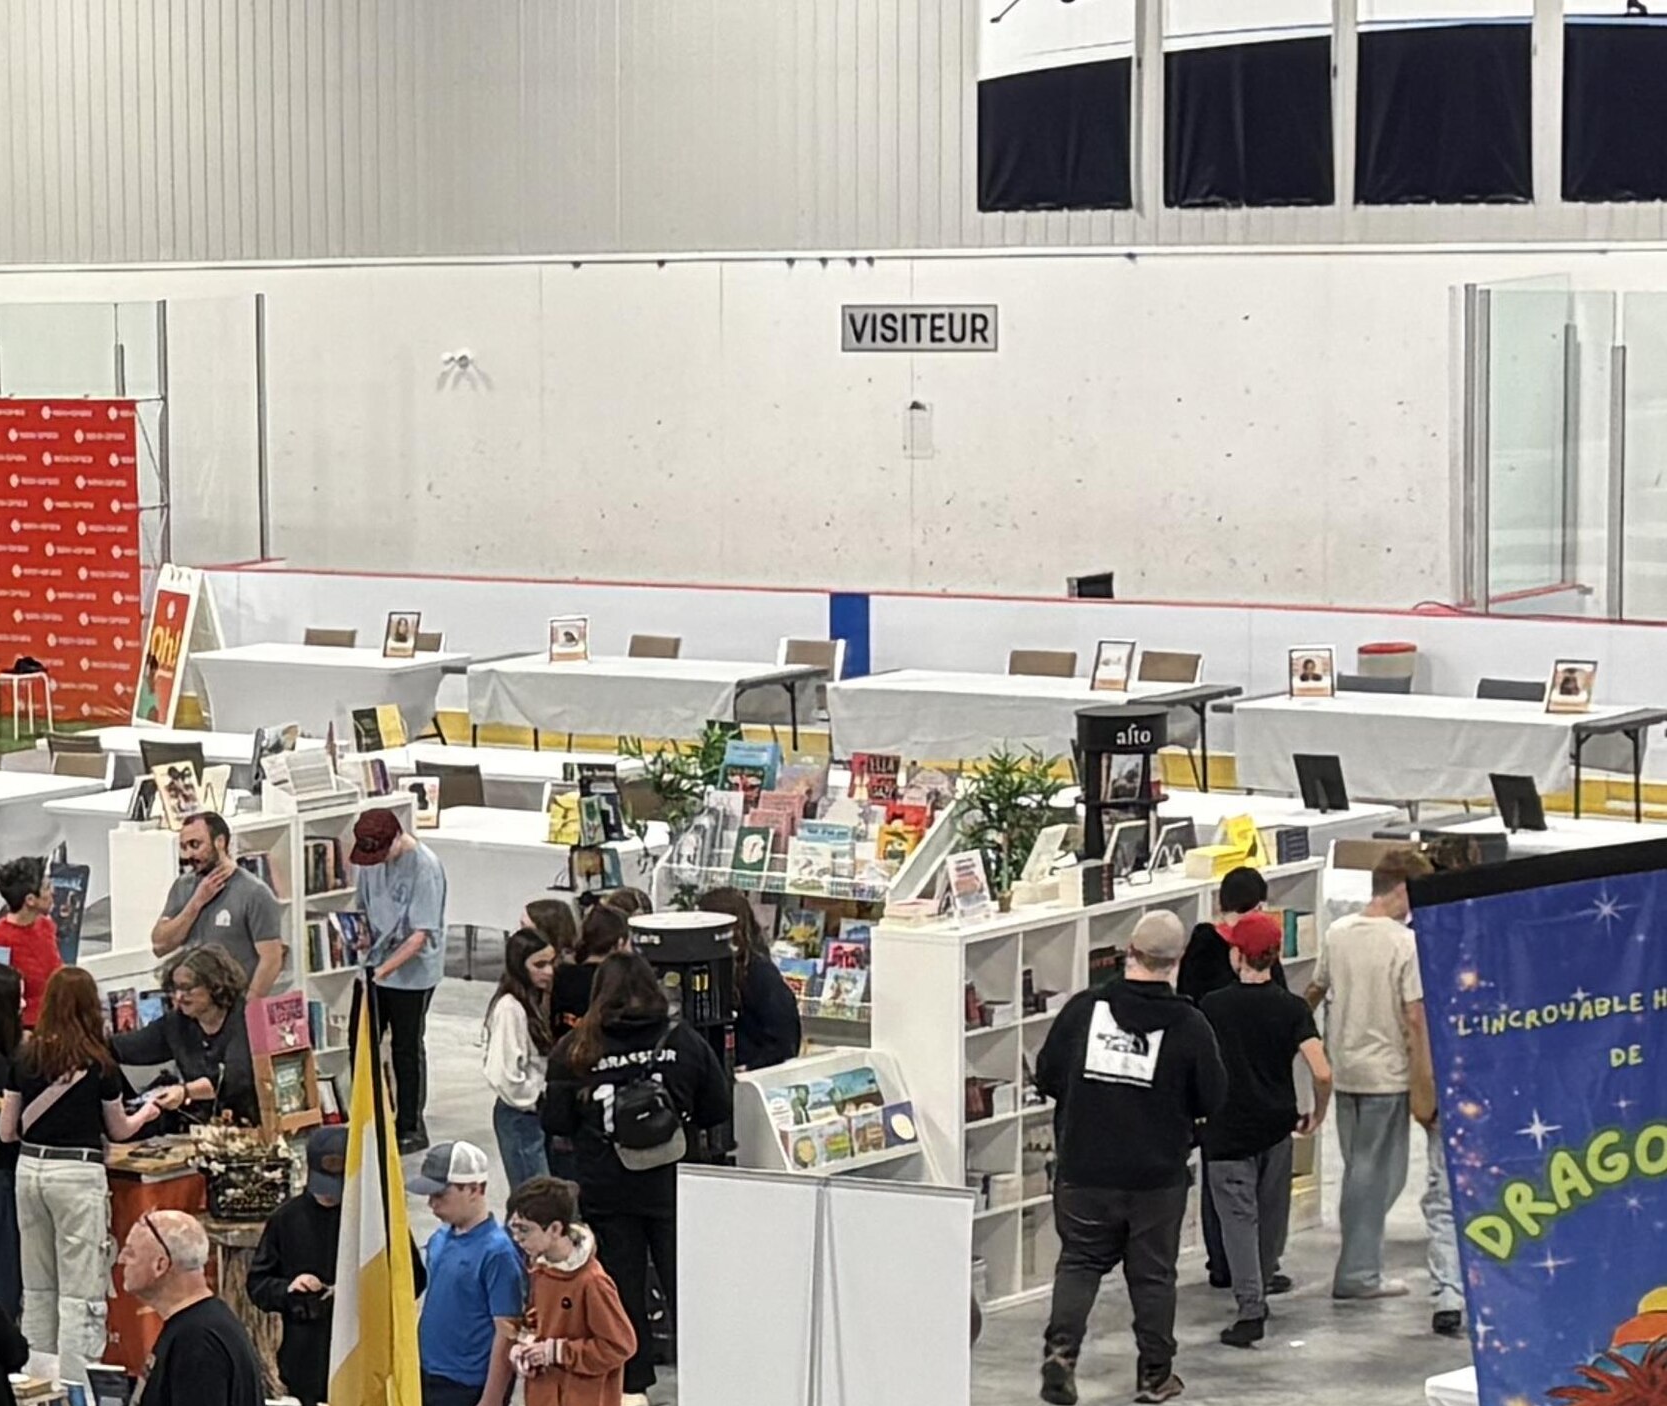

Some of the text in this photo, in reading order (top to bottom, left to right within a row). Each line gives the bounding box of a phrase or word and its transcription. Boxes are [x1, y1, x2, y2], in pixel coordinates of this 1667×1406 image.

[847, 312, 990, 344] VISITEUR
[1456, 992, 1645, 1037] L'INCROYABLE
[1609, 1045, 1644, 1068] DE
